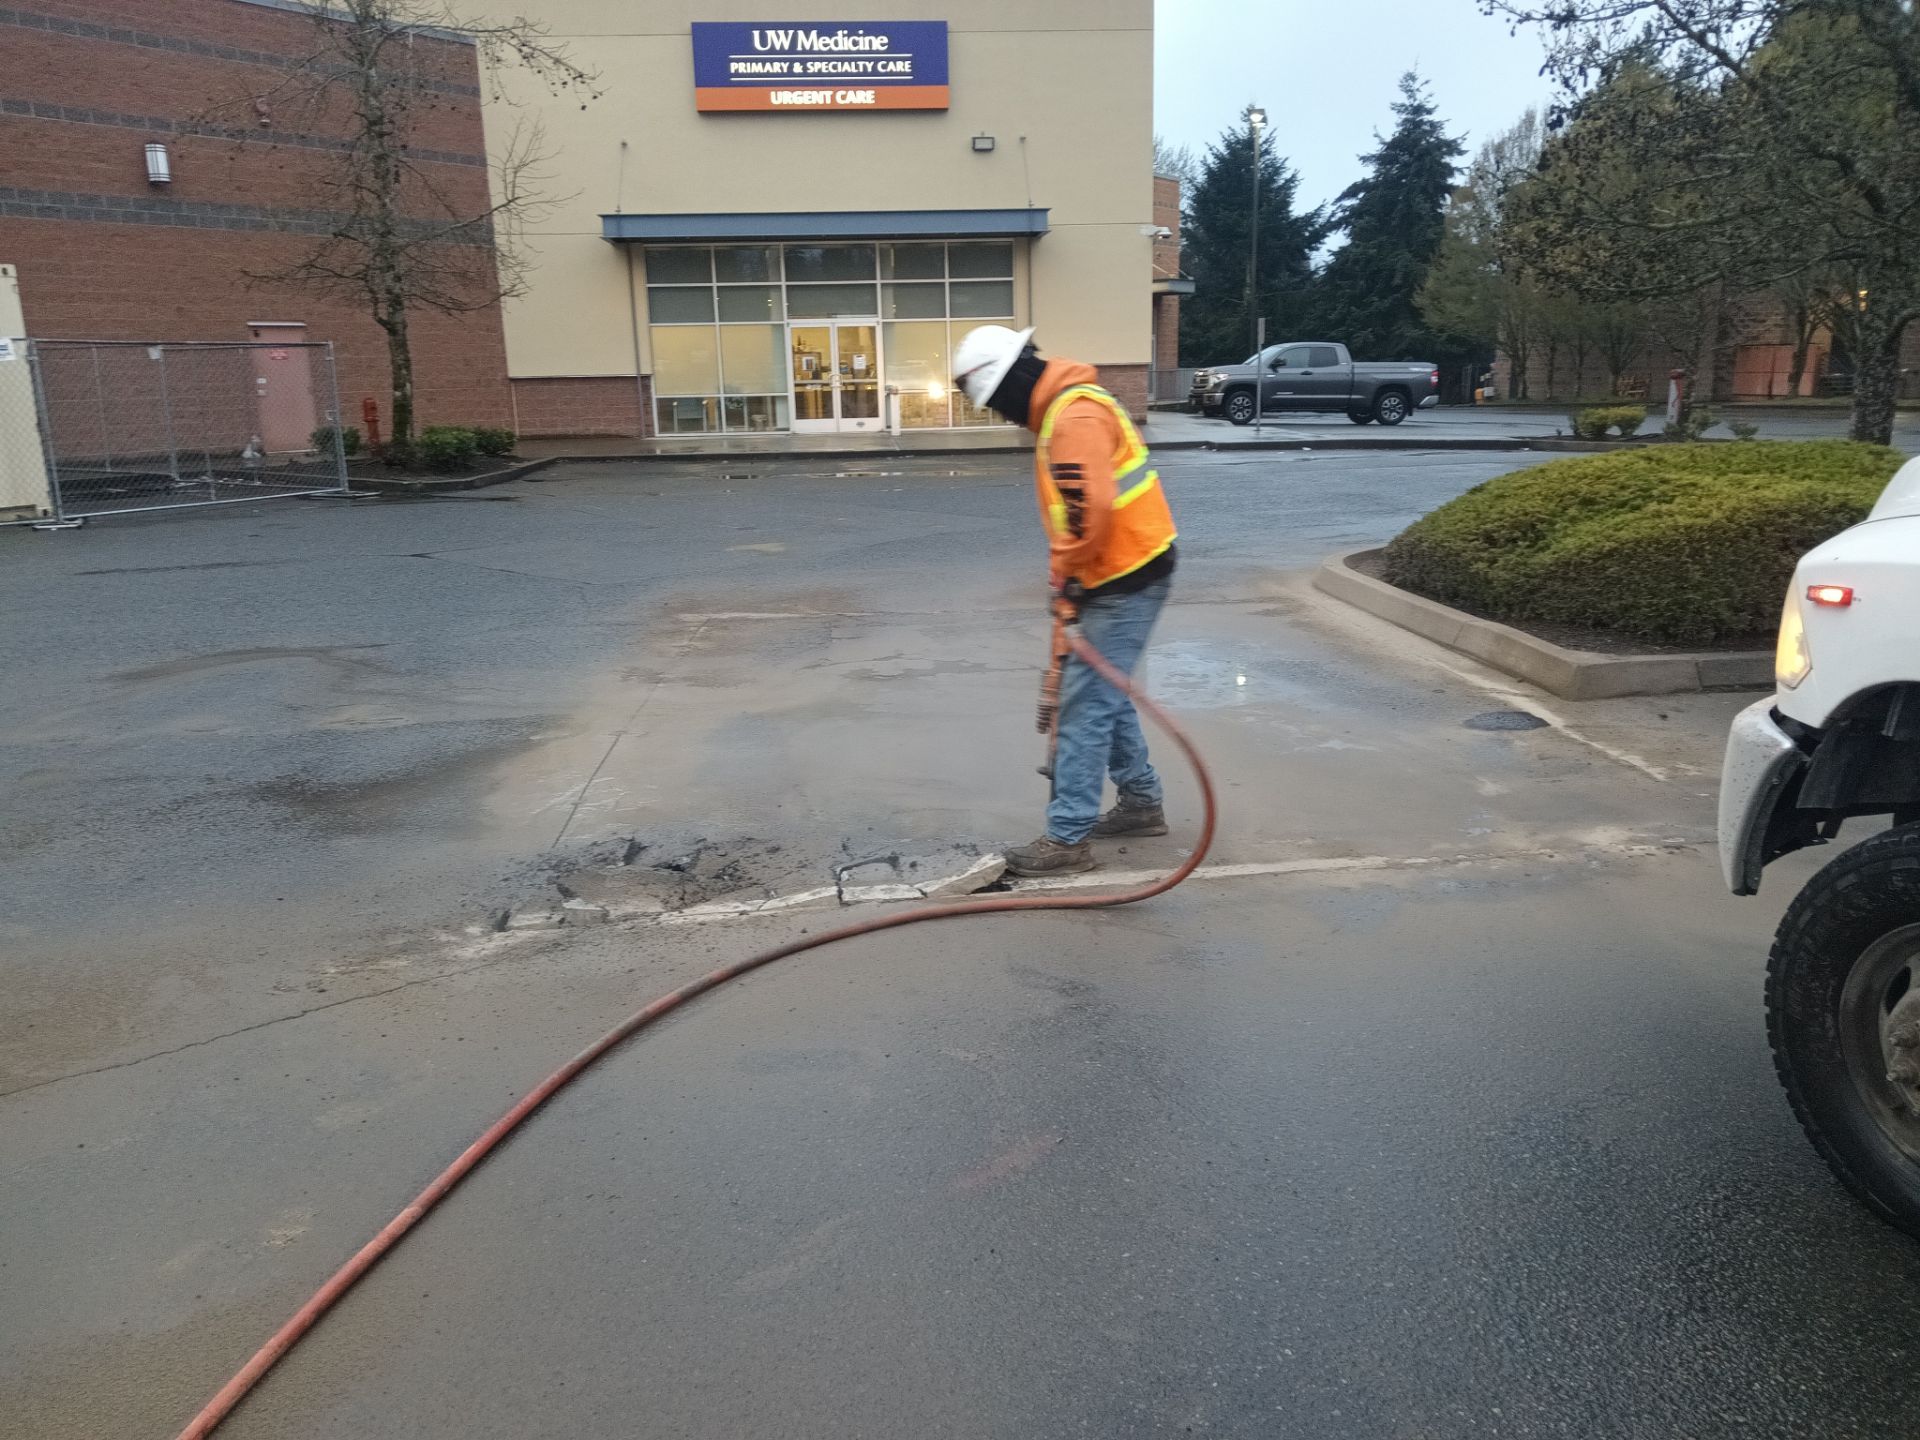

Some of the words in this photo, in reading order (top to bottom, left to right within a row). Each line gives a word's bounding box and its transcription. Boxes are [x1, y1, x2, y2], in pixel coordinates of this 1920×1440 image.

[752, 29, 795, 51] UW
[796, 29, 889, 51] Medicine
[730, 61, 790, 73] PRIMARY
[793, 61, 804, 73] &
[806, 61, 875, 73] SPECIALTY
[877, 60, 912, 73] CARE
[770, 90, 833, 105] URGENT
[835, 90, 876, 104] CARE
